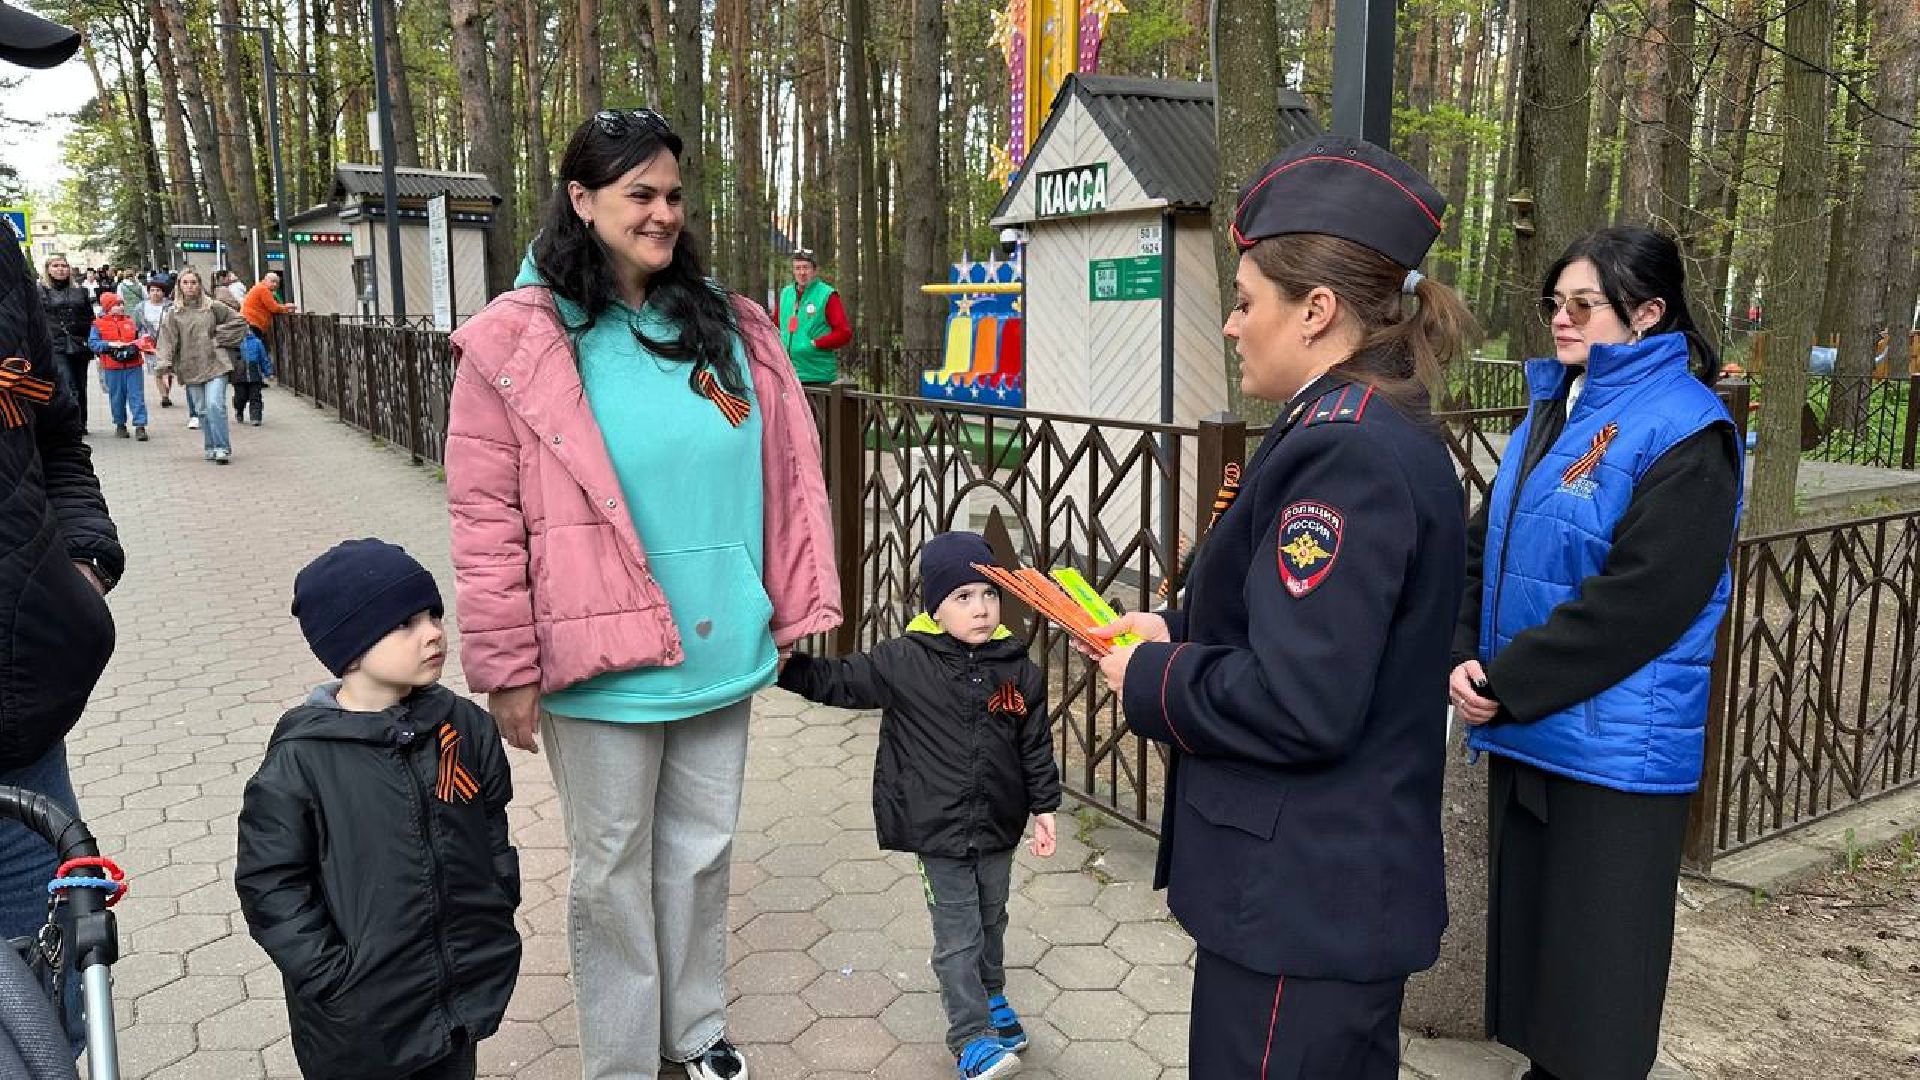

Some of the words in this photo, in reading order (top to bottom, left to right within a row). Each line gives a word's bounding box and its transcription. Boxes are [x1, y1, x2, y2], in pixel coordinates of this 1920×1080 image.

[1040, 168, 1105, 216] КАССА
[1284, 505, 1339, 529] ПОЛИЦИЯ
[1287, 519, 1330, 541] РОССИЯ
